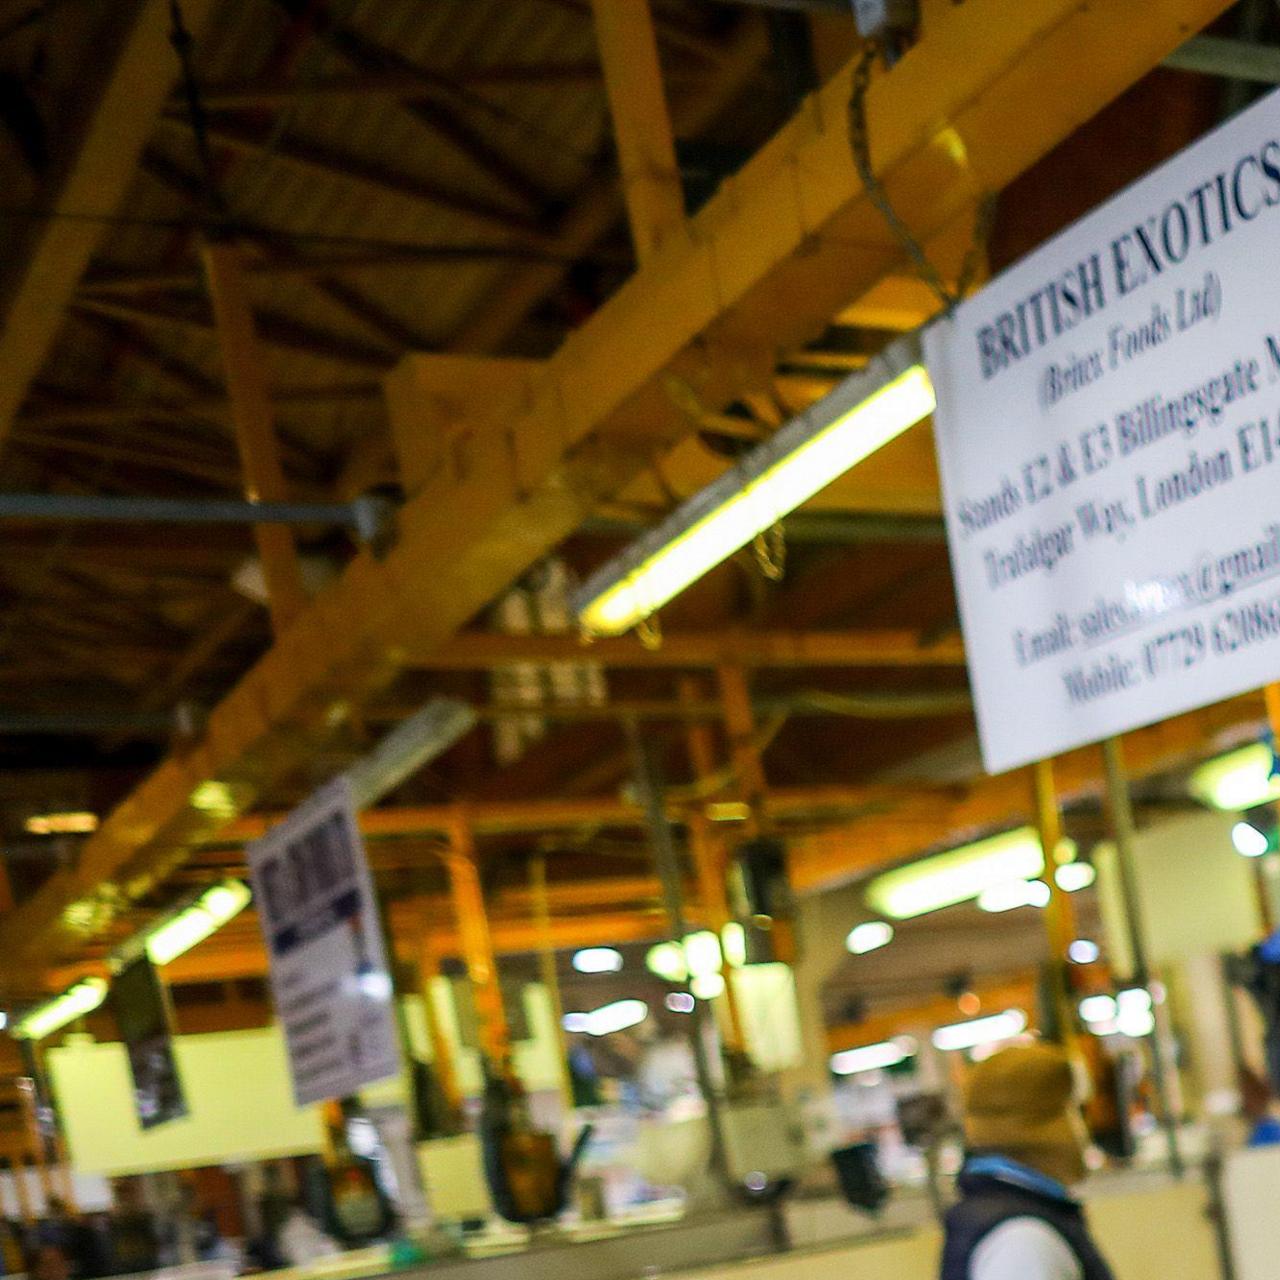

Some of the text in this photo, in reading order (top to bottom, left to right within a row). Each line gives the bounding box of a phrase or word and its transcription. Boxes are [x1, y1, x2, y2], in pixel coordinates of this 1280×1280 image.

[975, 254, 1106, 380] BRITISH
[1022, 455, 1054, 504] E2
[1057, 441, 1078, 488] &
[1116, 359, 1259, 456] Billingsgate
[984, 522, 1076, 588] Trafalgar
[1136, 450, 1233, 519] London
